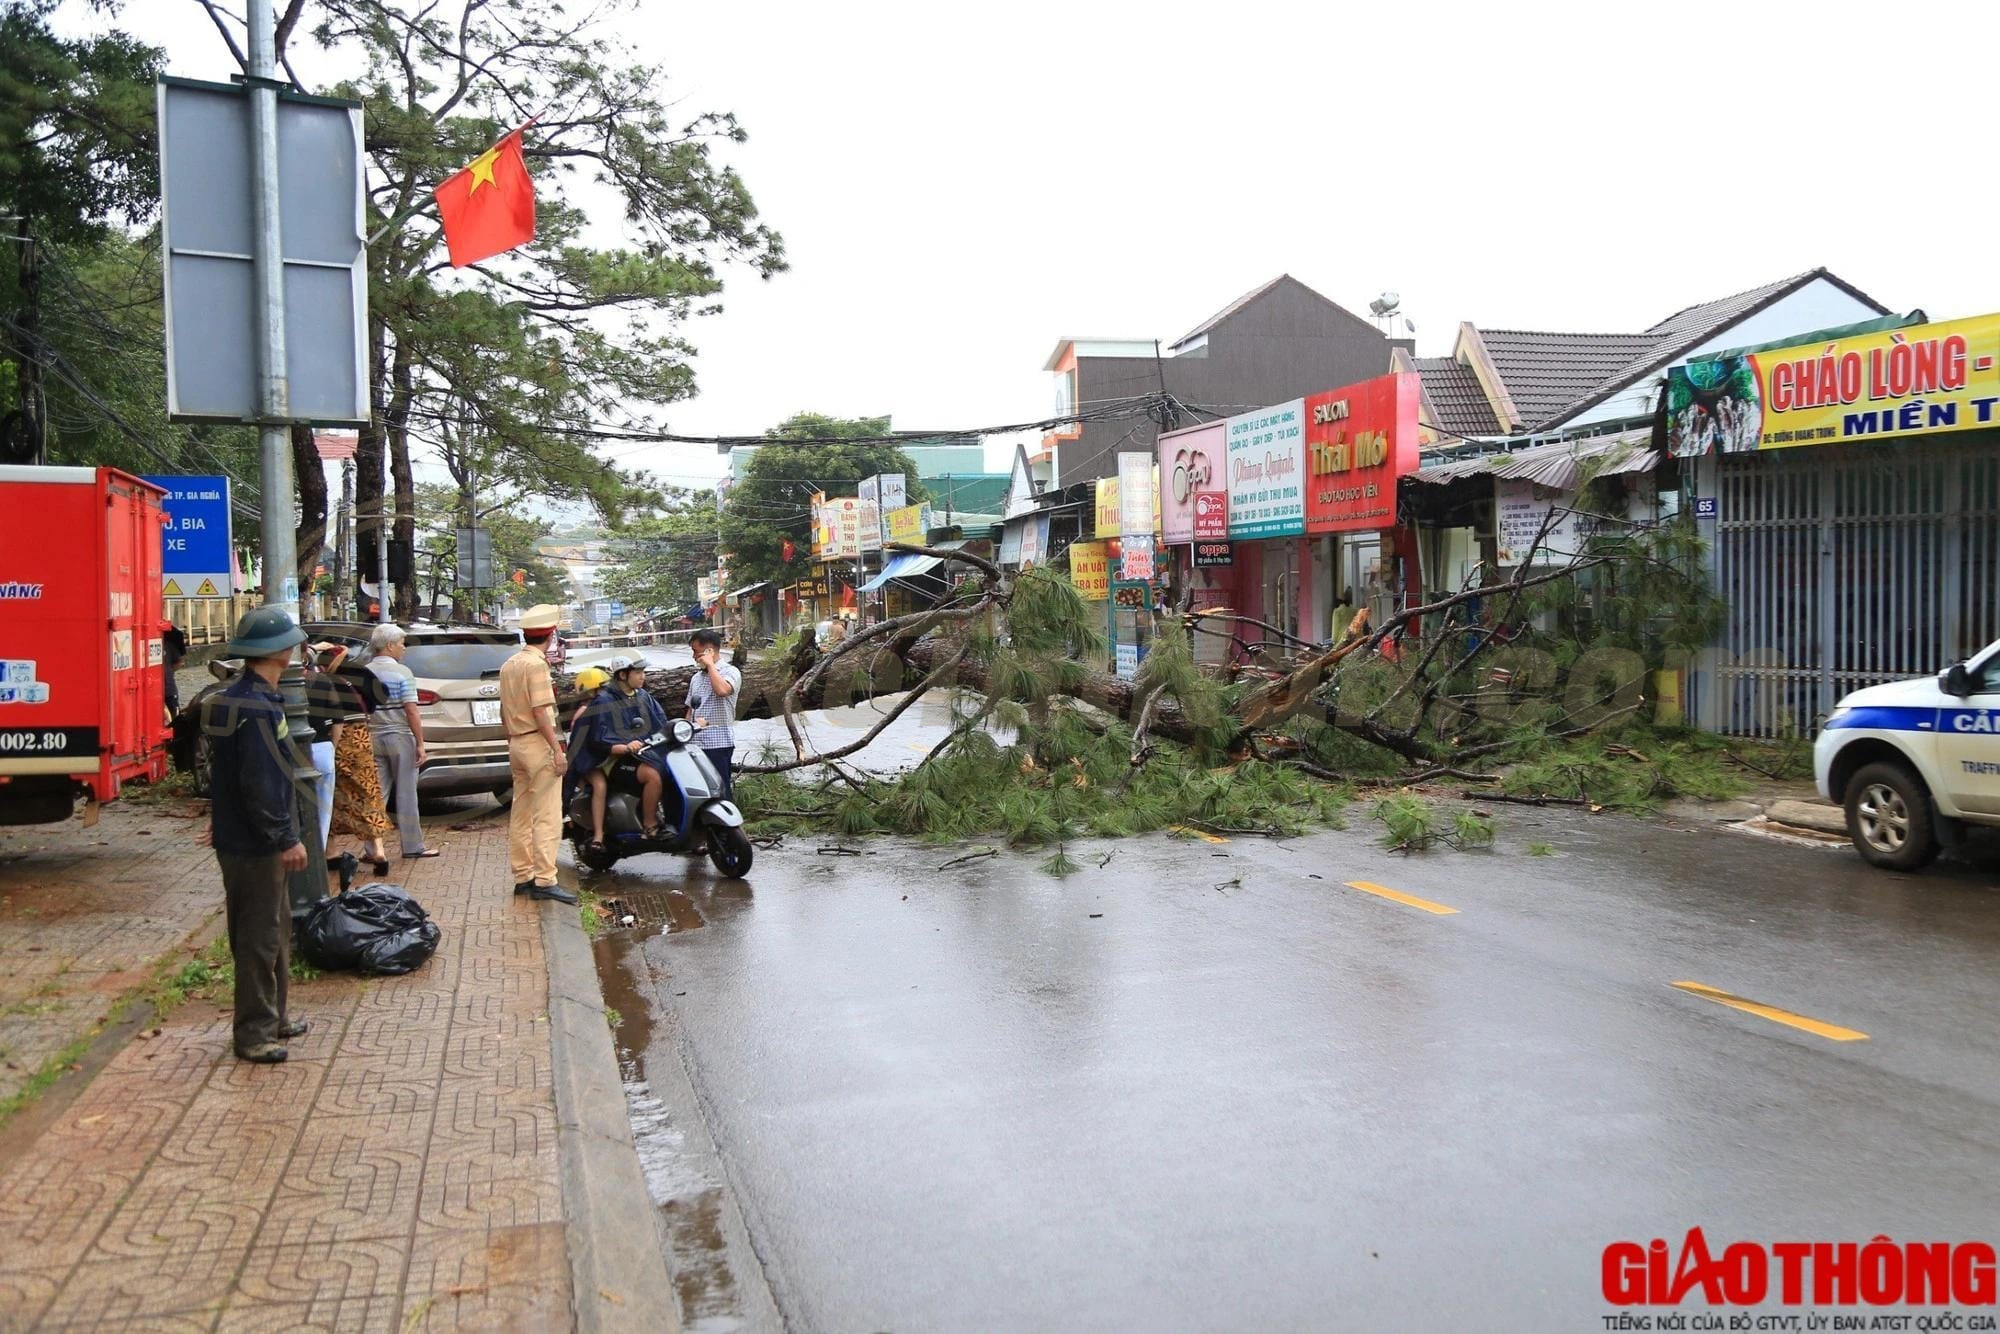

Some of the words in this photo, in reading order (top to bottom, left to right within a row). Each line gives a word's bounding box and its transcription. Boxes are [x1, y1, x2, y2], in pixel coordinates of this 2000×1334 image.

[1769, 343, 1863, 413] CHÁO
[1868, 333, 1968, 400] LÒNG
[1313, 399, 1349, 425] SALON
[1843, 400, 1957, 436] MIỀN
[1699, 500, 1713, 512] 65
[182, 518, 206, 530] BIA
[167, 539, 186, 551] XE
[0, 732, 67, 750] 002.80
